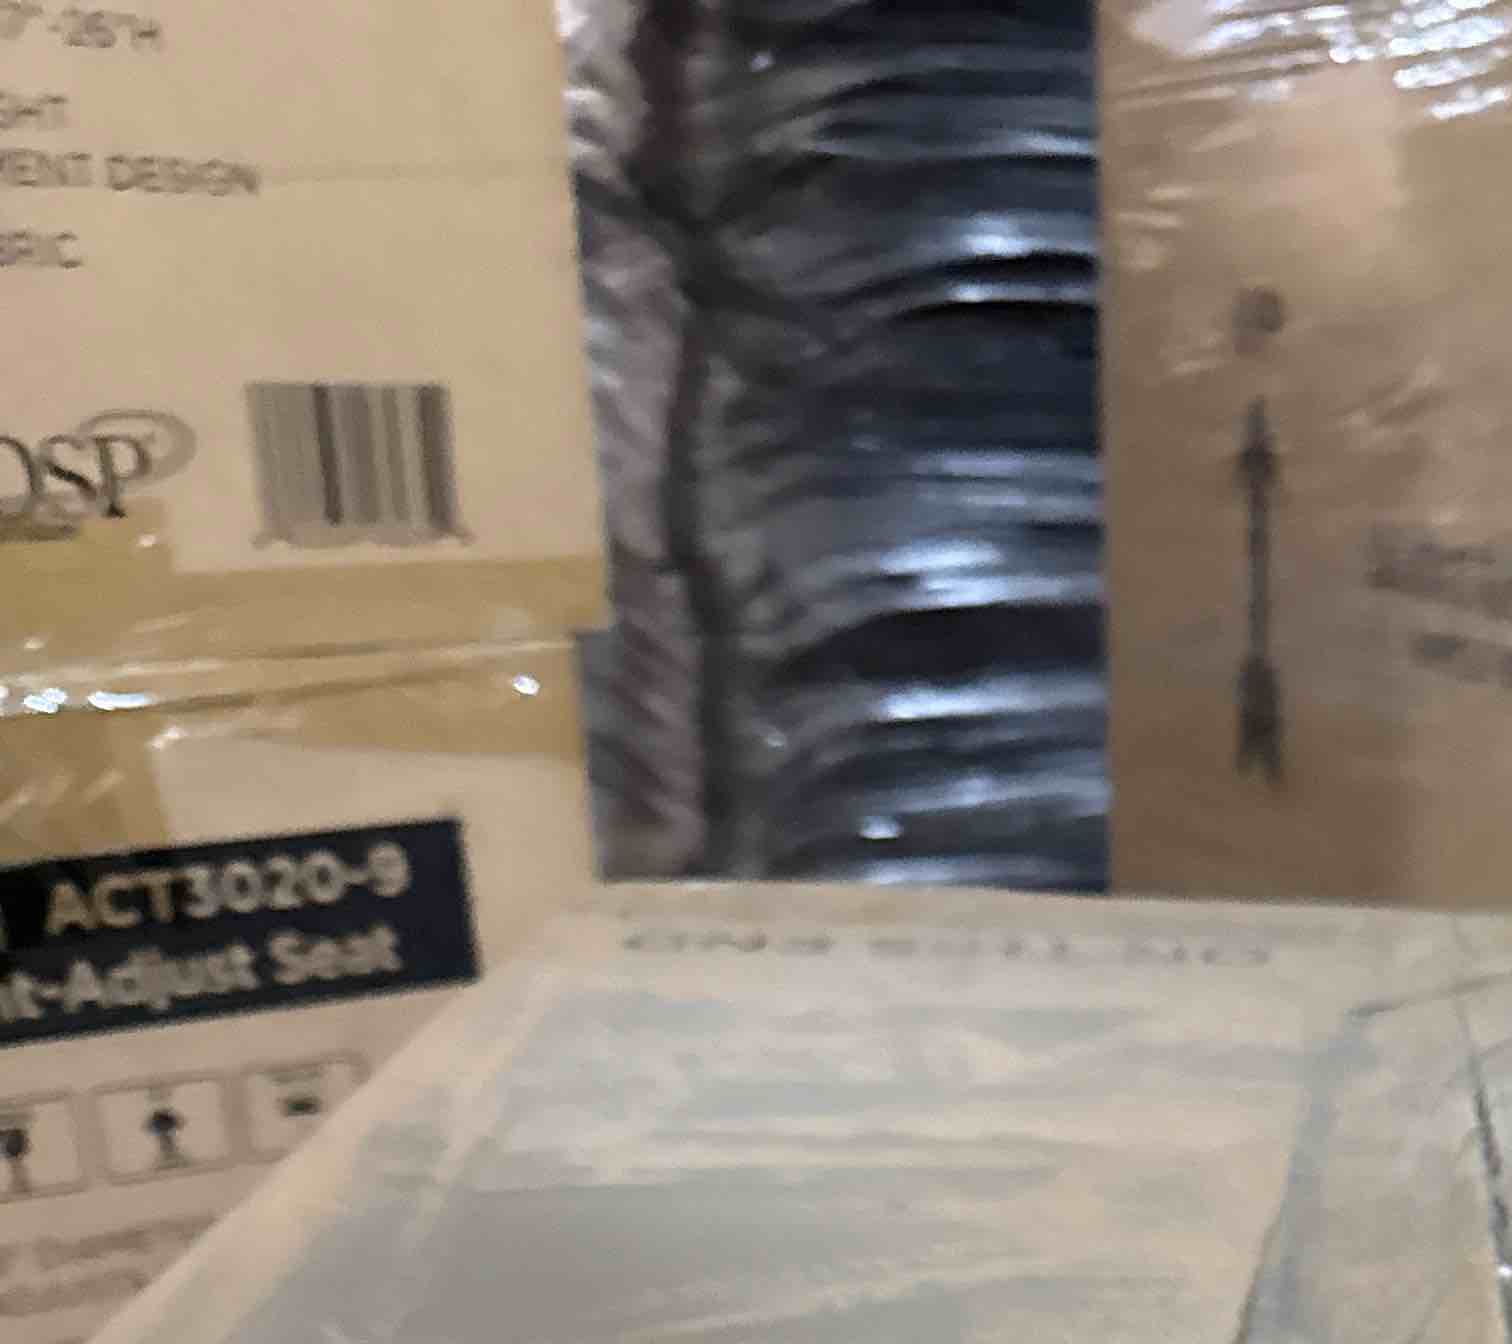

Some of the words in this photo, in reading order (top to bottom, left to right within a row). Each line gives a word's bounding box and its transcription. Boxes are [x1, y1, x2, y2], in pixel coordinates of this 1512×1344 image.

[0, 147, 93, 188] ENT
[104, 153, 261, 198] DESIGN
[46, 839, 411, 934] ACT3020-9
